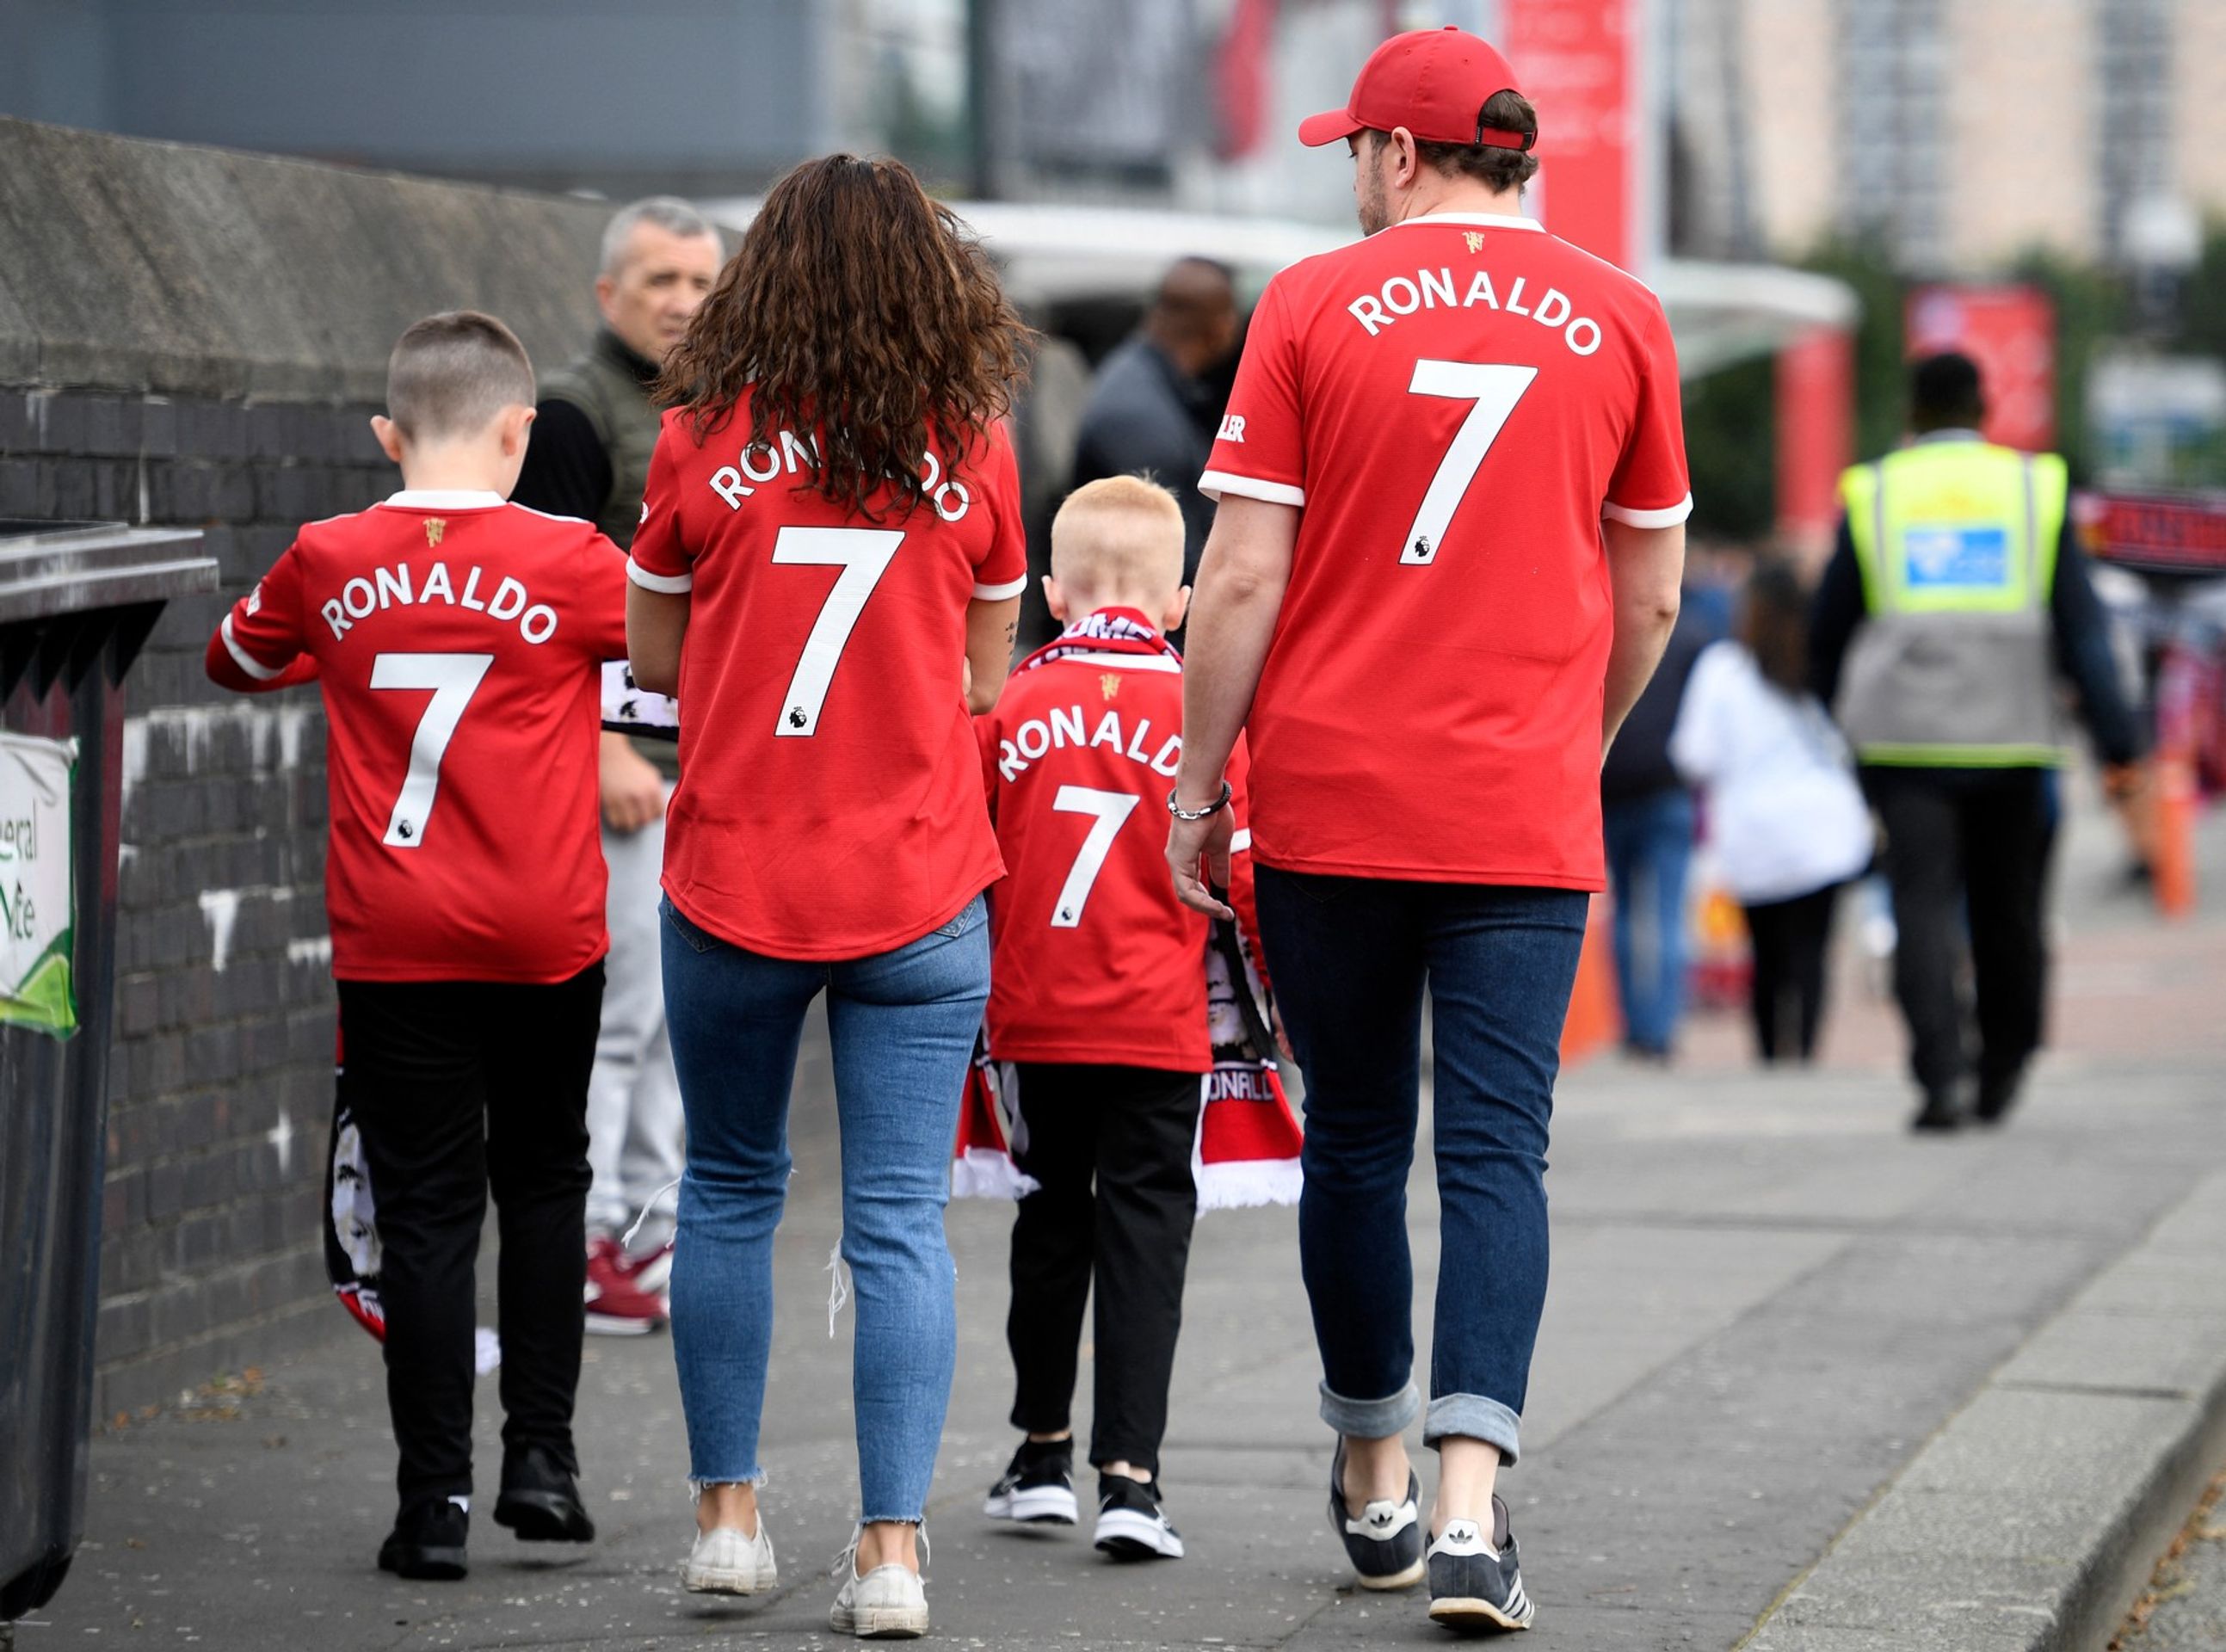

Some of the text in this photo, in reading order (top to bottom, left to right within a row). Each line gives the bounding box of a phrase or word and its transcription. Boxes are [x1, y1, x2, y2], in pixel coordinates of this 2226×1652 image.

[1347, 268, 1601, 356] RONALDO
[1215, 414, 1247, 443] LER
[1398, 358, 1538, 566] 7
[320, 562, 558, 644] RONALDO
[771, 526, 906, 737] 7
[369, 652, 495, 848] 7
[998, 705, 1184, 783] RONALD
[0, 798, 37, 860] eral
[1050, 785, 1141, 928] 7
